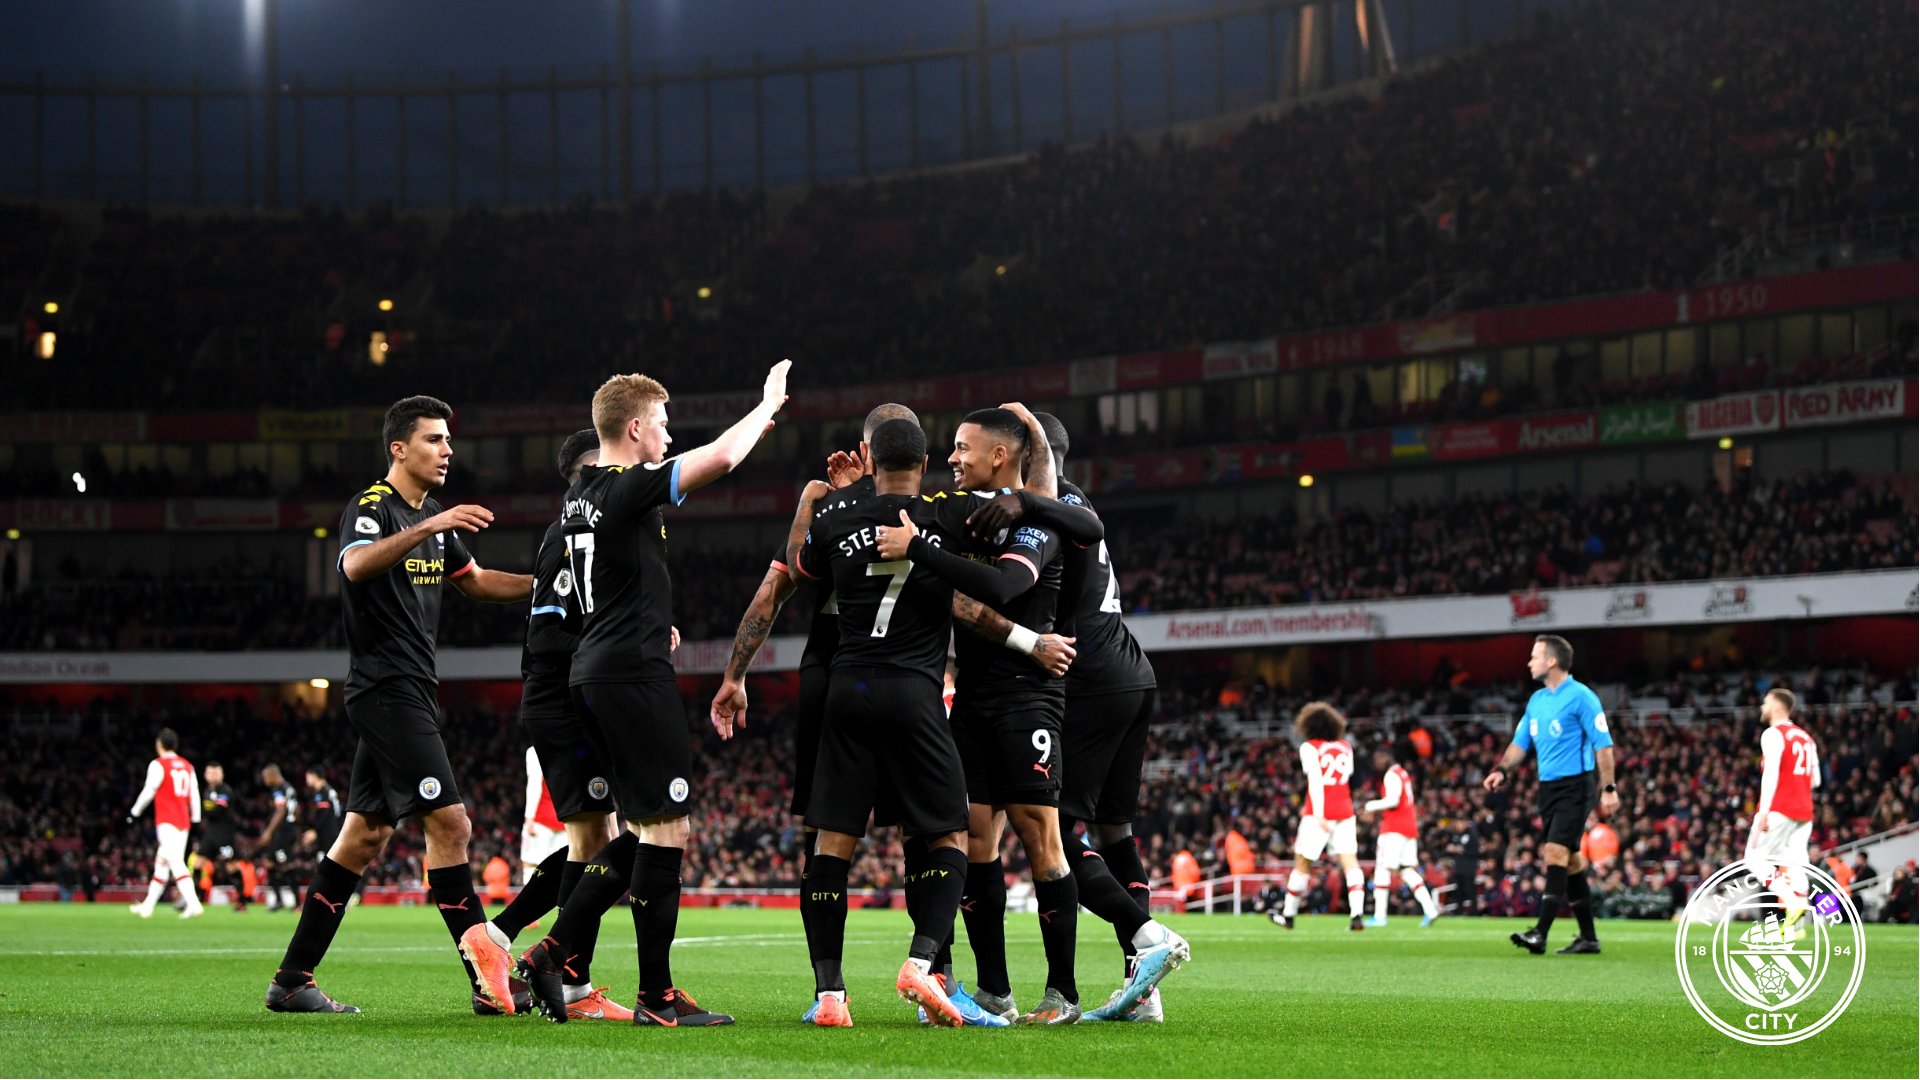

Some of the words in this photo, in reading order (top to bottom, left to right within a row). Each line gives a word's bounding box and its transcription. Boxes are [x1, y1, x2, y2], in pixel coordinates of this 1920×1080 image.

[1707, 284, 1767, 316] 1950
[1788, 391, 1830, 419] RED
[1837, 385, 1897, 415] ARMY
[1517, 415, 1594, 448] Arsenal
[838, 526, 943, 558] STEG
[1015, 535, 1040, 549] TIRE
[564, 532, 596, 615] 17
[865, 559, 916, 638] 7
[1031, 728, 1052, 763] 9
[1791, 740, 1813, 777] 21
[169, 768, 191, 798] 10
[1319, 752, 1351, 786] 29
[811, 891, 840, 902] CITY
